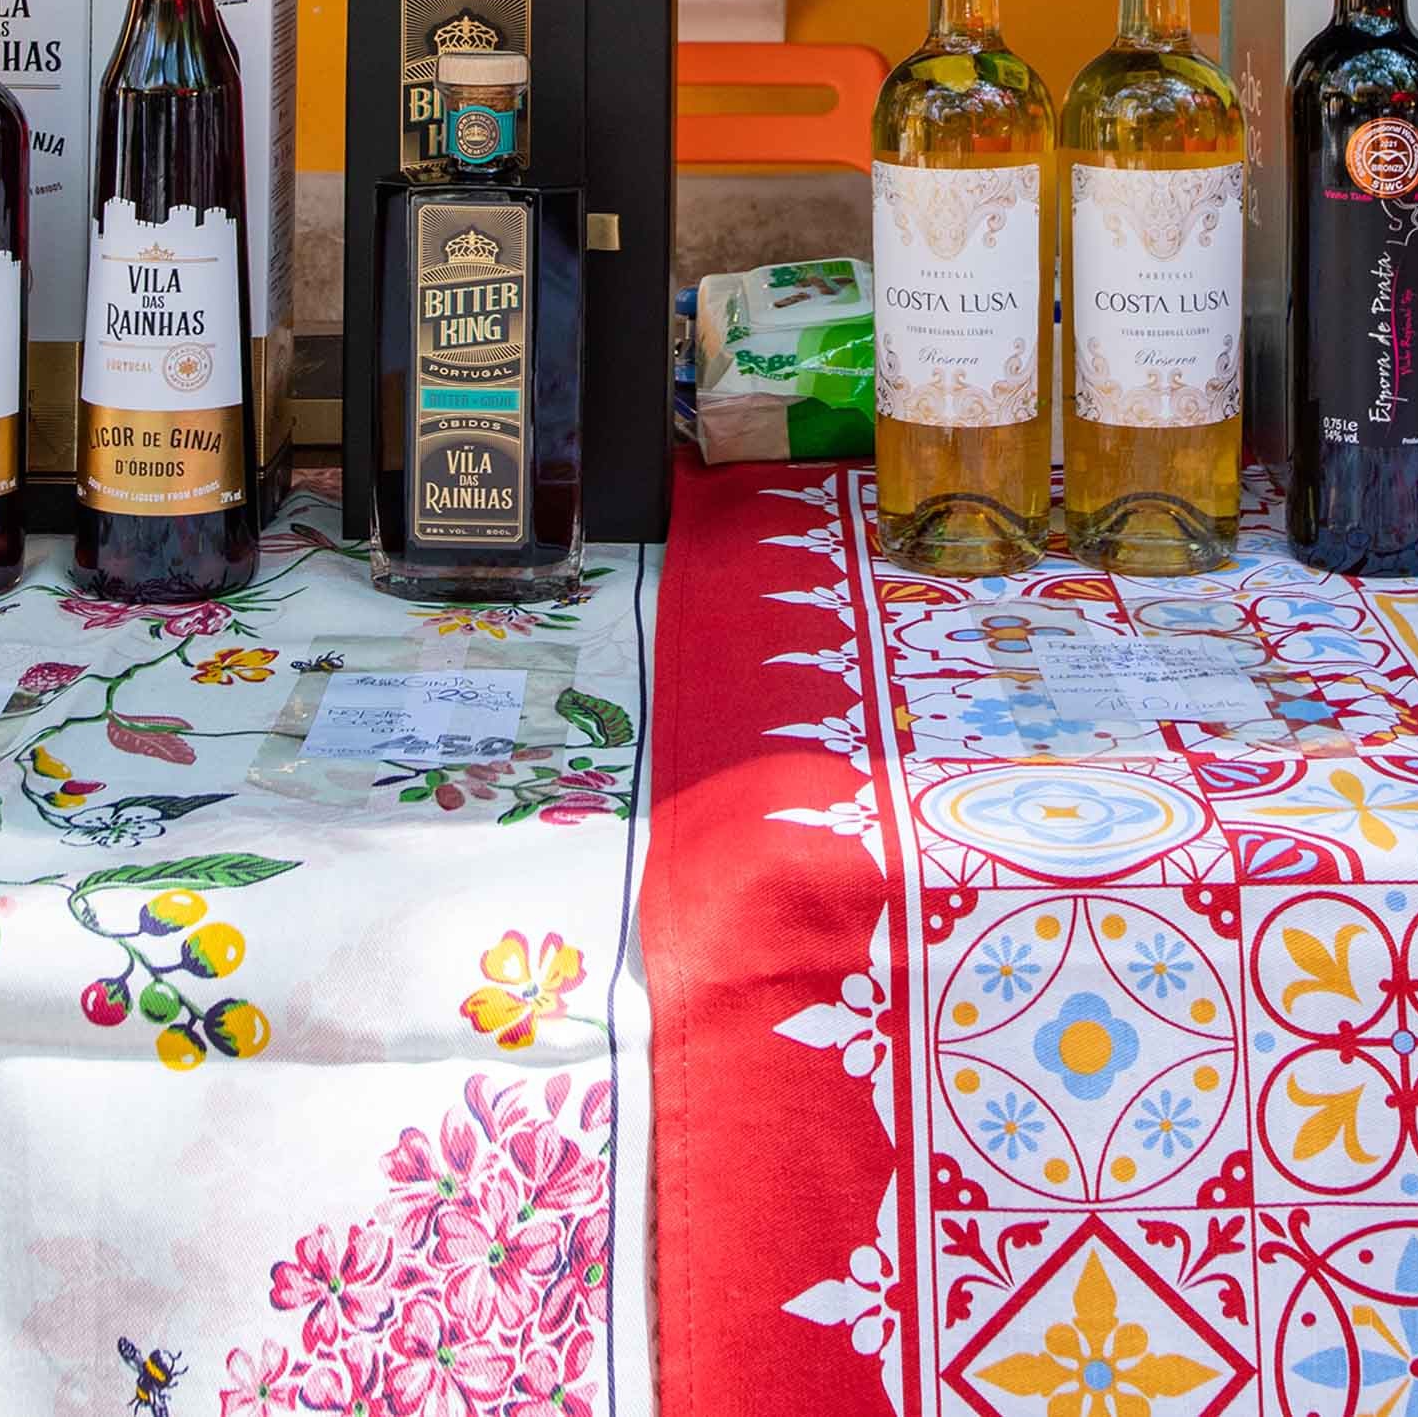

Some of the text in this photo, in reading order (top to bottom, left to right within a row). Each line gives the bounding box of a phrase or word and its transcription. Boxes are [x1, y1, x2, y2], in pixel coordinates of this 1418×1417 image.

[32, 130, 65, 157] NJA
[1379, 140, 1398, 148] 2021
[1401, 126, 1416, 144] Wine
[1371, 164, 1403, 173] BRONZE
[1371, 180, 1403, 191] SIWC
[128, 265, 181, 294] VILA
[142, 295, 165, 309] DAS
[425, 282, 519, 318] BITTER
[886, 286, 1018, 313] COSTA LUSA
[1095, 290, 1230, 313] COSTA LUSA
[107, 303, 205, 340] RAINHAS
[440, 314, 502, 346] KING
[1368, 251, 1408, 422] Espora de Prata
[918, 347, 980, 365] Reserva
[1134, 349, 1200, 366] Reserva
[429, 364, 512, 378] PORTUGAL
[438, 418, 501, 431] ÓBIDOS
[90, 427, 222, 454] LICOR DE GINJA
[1325, 430, 1342, 442] 14%
[115, 459, 185, 477] D'ÓBIDOS
[446, 450, 492, 474] VILA
[459, 474, 479, 487] DAS
[425, 482, 513, 513] RAINHAS
